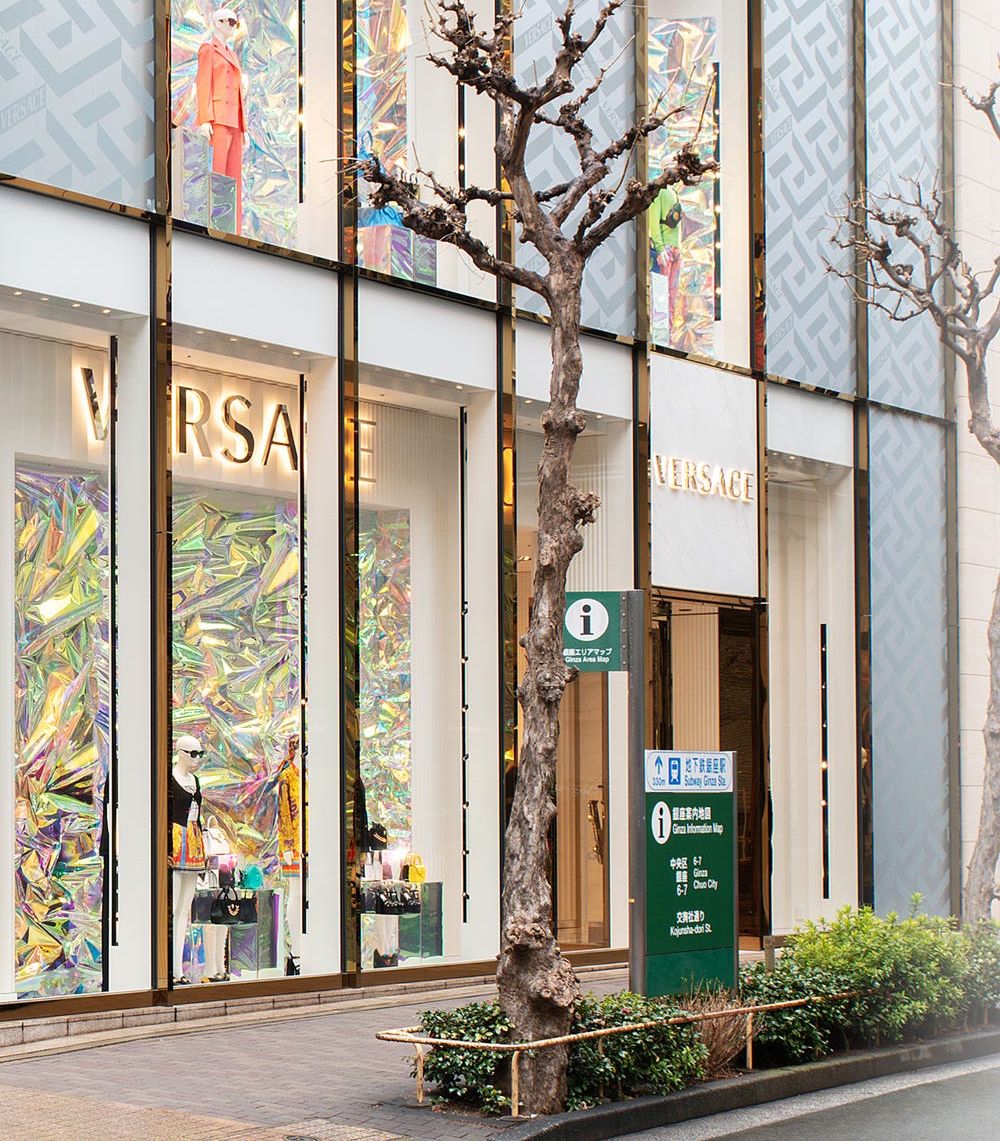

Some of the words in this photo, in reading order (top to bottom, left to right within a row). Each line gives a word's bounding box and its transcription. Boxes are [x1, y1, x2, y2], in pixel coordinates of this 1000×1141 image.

[653, 454, 754, 502] VERSACE
[597, 656, 610, 664] Map
[685, 757, 727, 774] 地下鉄銀座駅
[684, 775, 702, 788] Subway
[704, 775, 717, 786] Ginza
[672, 807, 712, 820] 銀座案内地図
[672, 824, 686, 834] Ginza
[687, 823, 712, 834] Information
[713, 822, 724, 835] Map
[669, 857, 688, 870] 中央区
[693, 856, 702, 866] 6-7
[675, 870, 688, 883] 銀座
[693, 868, 708, 878] Ginza
[676, 884, 688, 897] 6-7
[693, 880, 707, 890] Chuo
[708, 879, 718, 890] City
[669, 924, 705, 938] Kojunsha-dori
